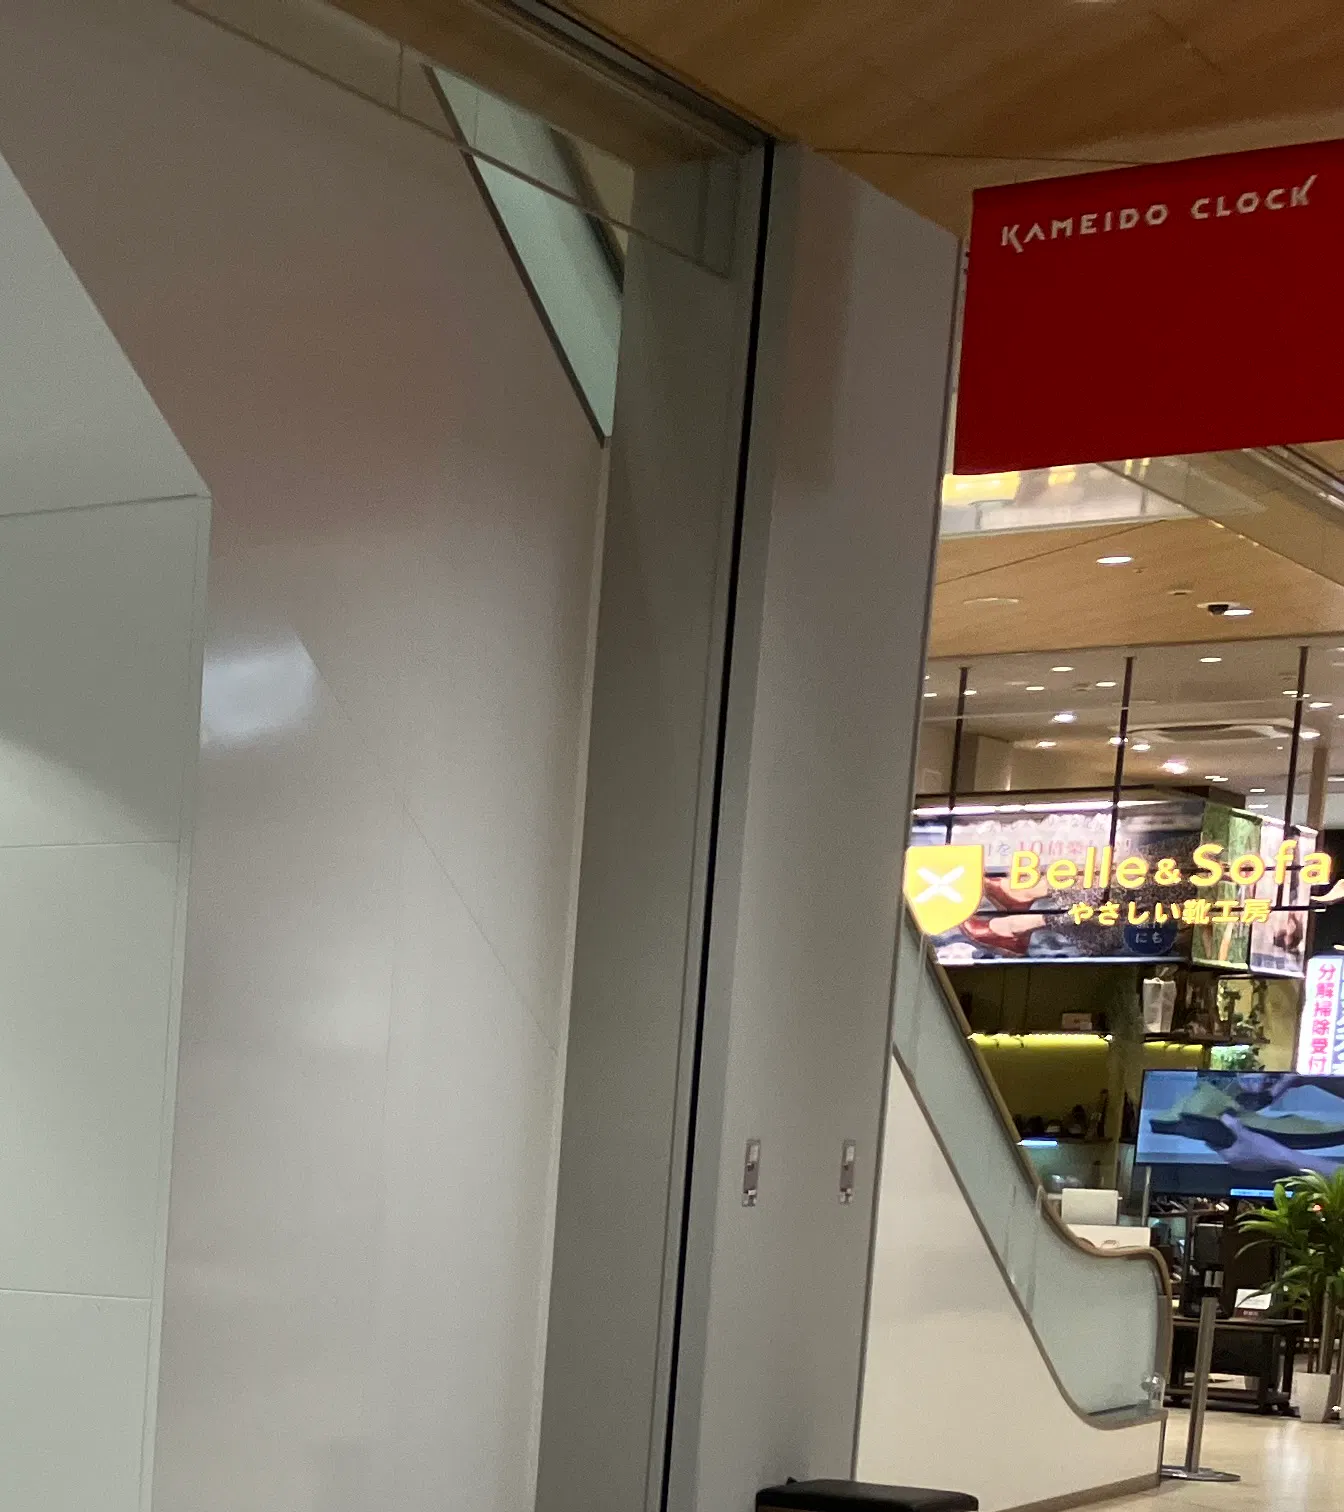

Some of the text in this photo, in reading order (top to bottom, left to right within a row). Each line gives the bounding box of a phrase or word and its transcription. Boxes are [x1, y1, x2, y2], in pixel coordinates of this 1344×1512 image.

[1000, 174, 1318, 253] KAMEIDO CLOCK
[1067, 898, 1274, 926] やさしい靴工房
